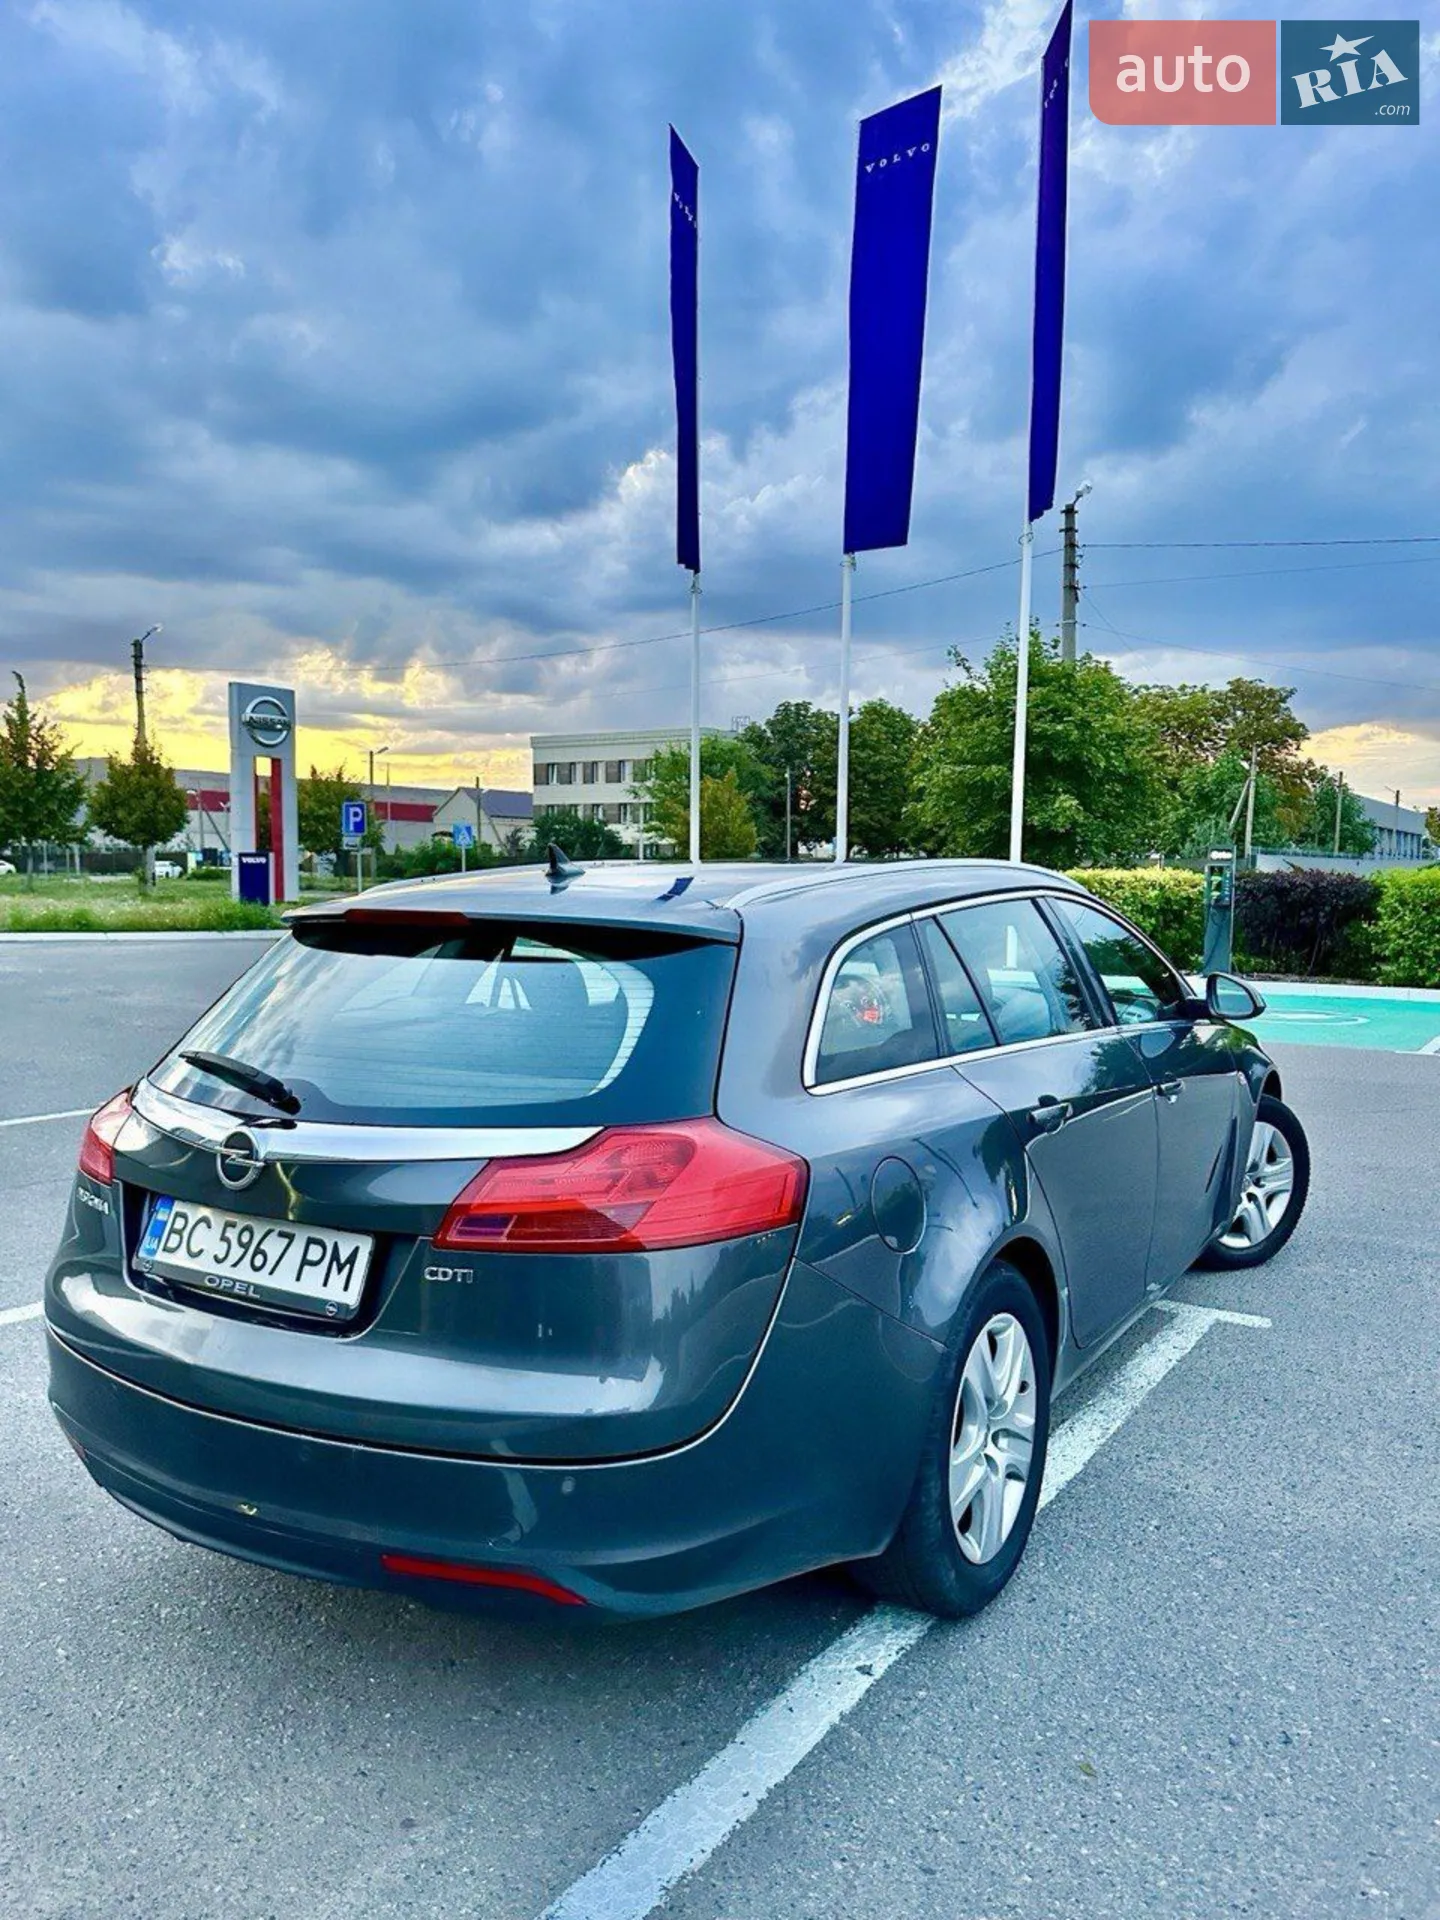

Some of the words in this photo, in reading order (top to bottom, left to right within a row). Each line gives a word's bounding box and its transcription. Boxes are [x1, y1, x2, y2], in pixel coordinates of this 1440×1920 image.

[865, 143, 930, 173] VOLVO
[349, 806, 362, 831] P
[162, 1211, 212, 1258] BC
[213, 1220, 296, 1275] 5967
[295, 1236, 360, 1292] PM
[204, 1275, 260, 1299] OPEL
